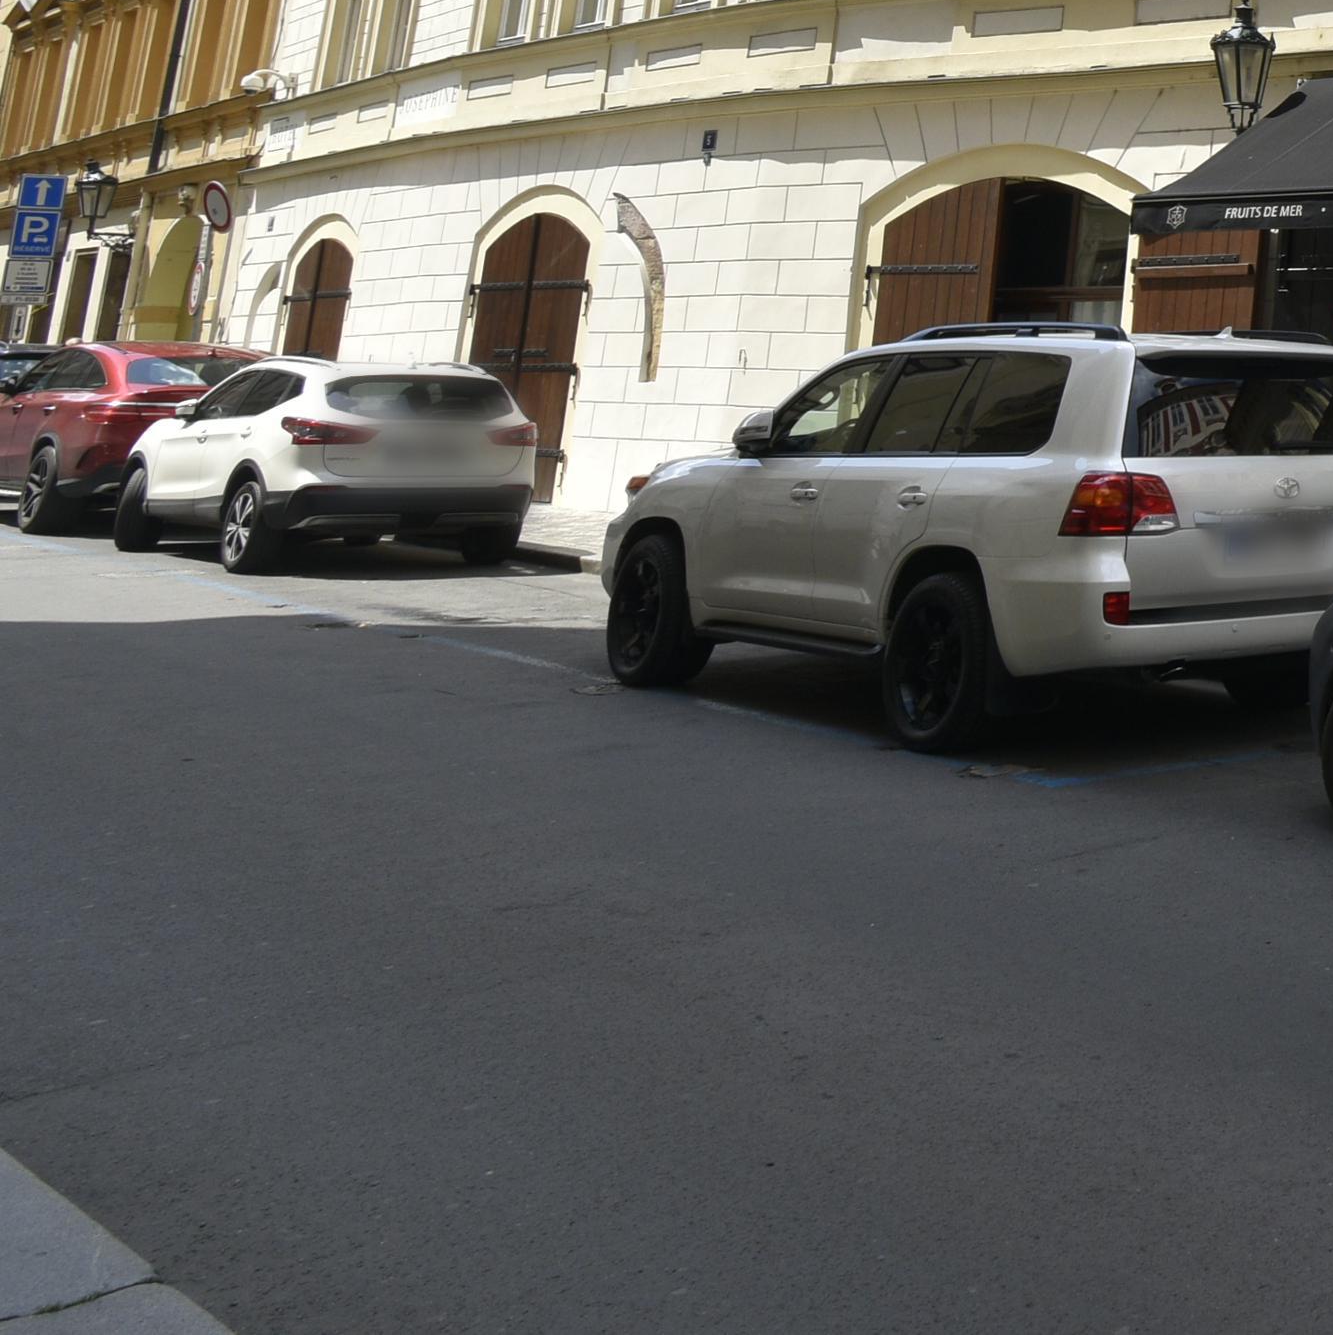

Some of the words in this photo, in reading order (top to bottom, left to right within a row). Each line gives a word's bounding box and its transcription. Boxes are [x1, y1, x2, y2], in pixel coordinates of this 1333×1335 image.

[1224, 206, 1261, 219] FRUITS
[1263, 206, 1277, 218] DE
[1279, 204, 1303, 217] MER
[20, 216, 50, 243] P
